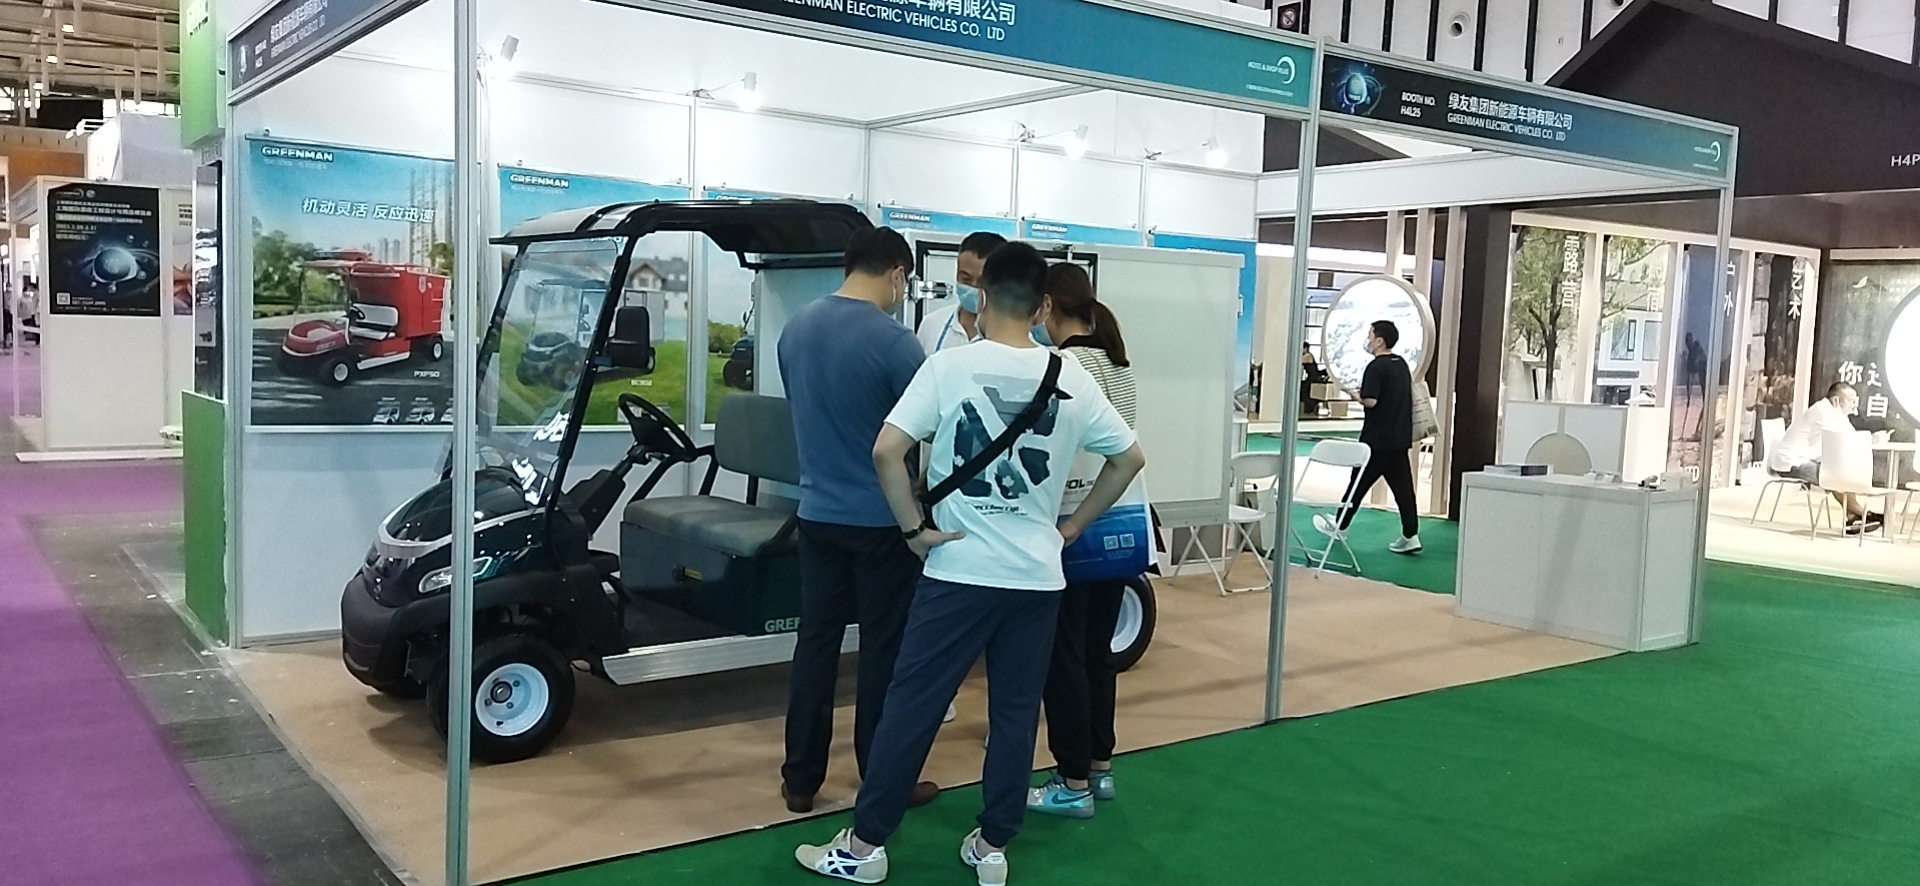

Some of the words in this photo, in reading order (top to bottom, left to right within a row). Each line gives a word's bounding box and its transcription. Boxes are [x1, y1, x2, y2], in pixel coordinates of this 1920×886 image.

[846, 0, 903, 23] ELECTRIC
[904, 10, 958, 33] VEHICLES
[960, 21, 982, 37] CO.
[986, 26, 1006, 41] LTD
[883, 0, 1015, 26] 辆有限公司
[1401, 91, 1424, 105] BOOTH
[1400, 105, 1422, 118] H4L25
[1447, 91, 1574, 130] 绿友集团新能源车辆有限公司
[1447, 112, 1485, 128] GREENMAN
[1485, 119, 1514, 133] ELECTRIC
[1514, 124, 1541, 137] VEHICLES
[261, 146, 333, 162] GREENMAN
[509, 173, 569, 188] GREENMAN
[302, 198, 368, 218] 机动灵活
[372, 204, 435, 223] 反应迅速
[889, 211, 931, 222] GREENMAN
[1031, 223, 1068, 233] GREENMAN
